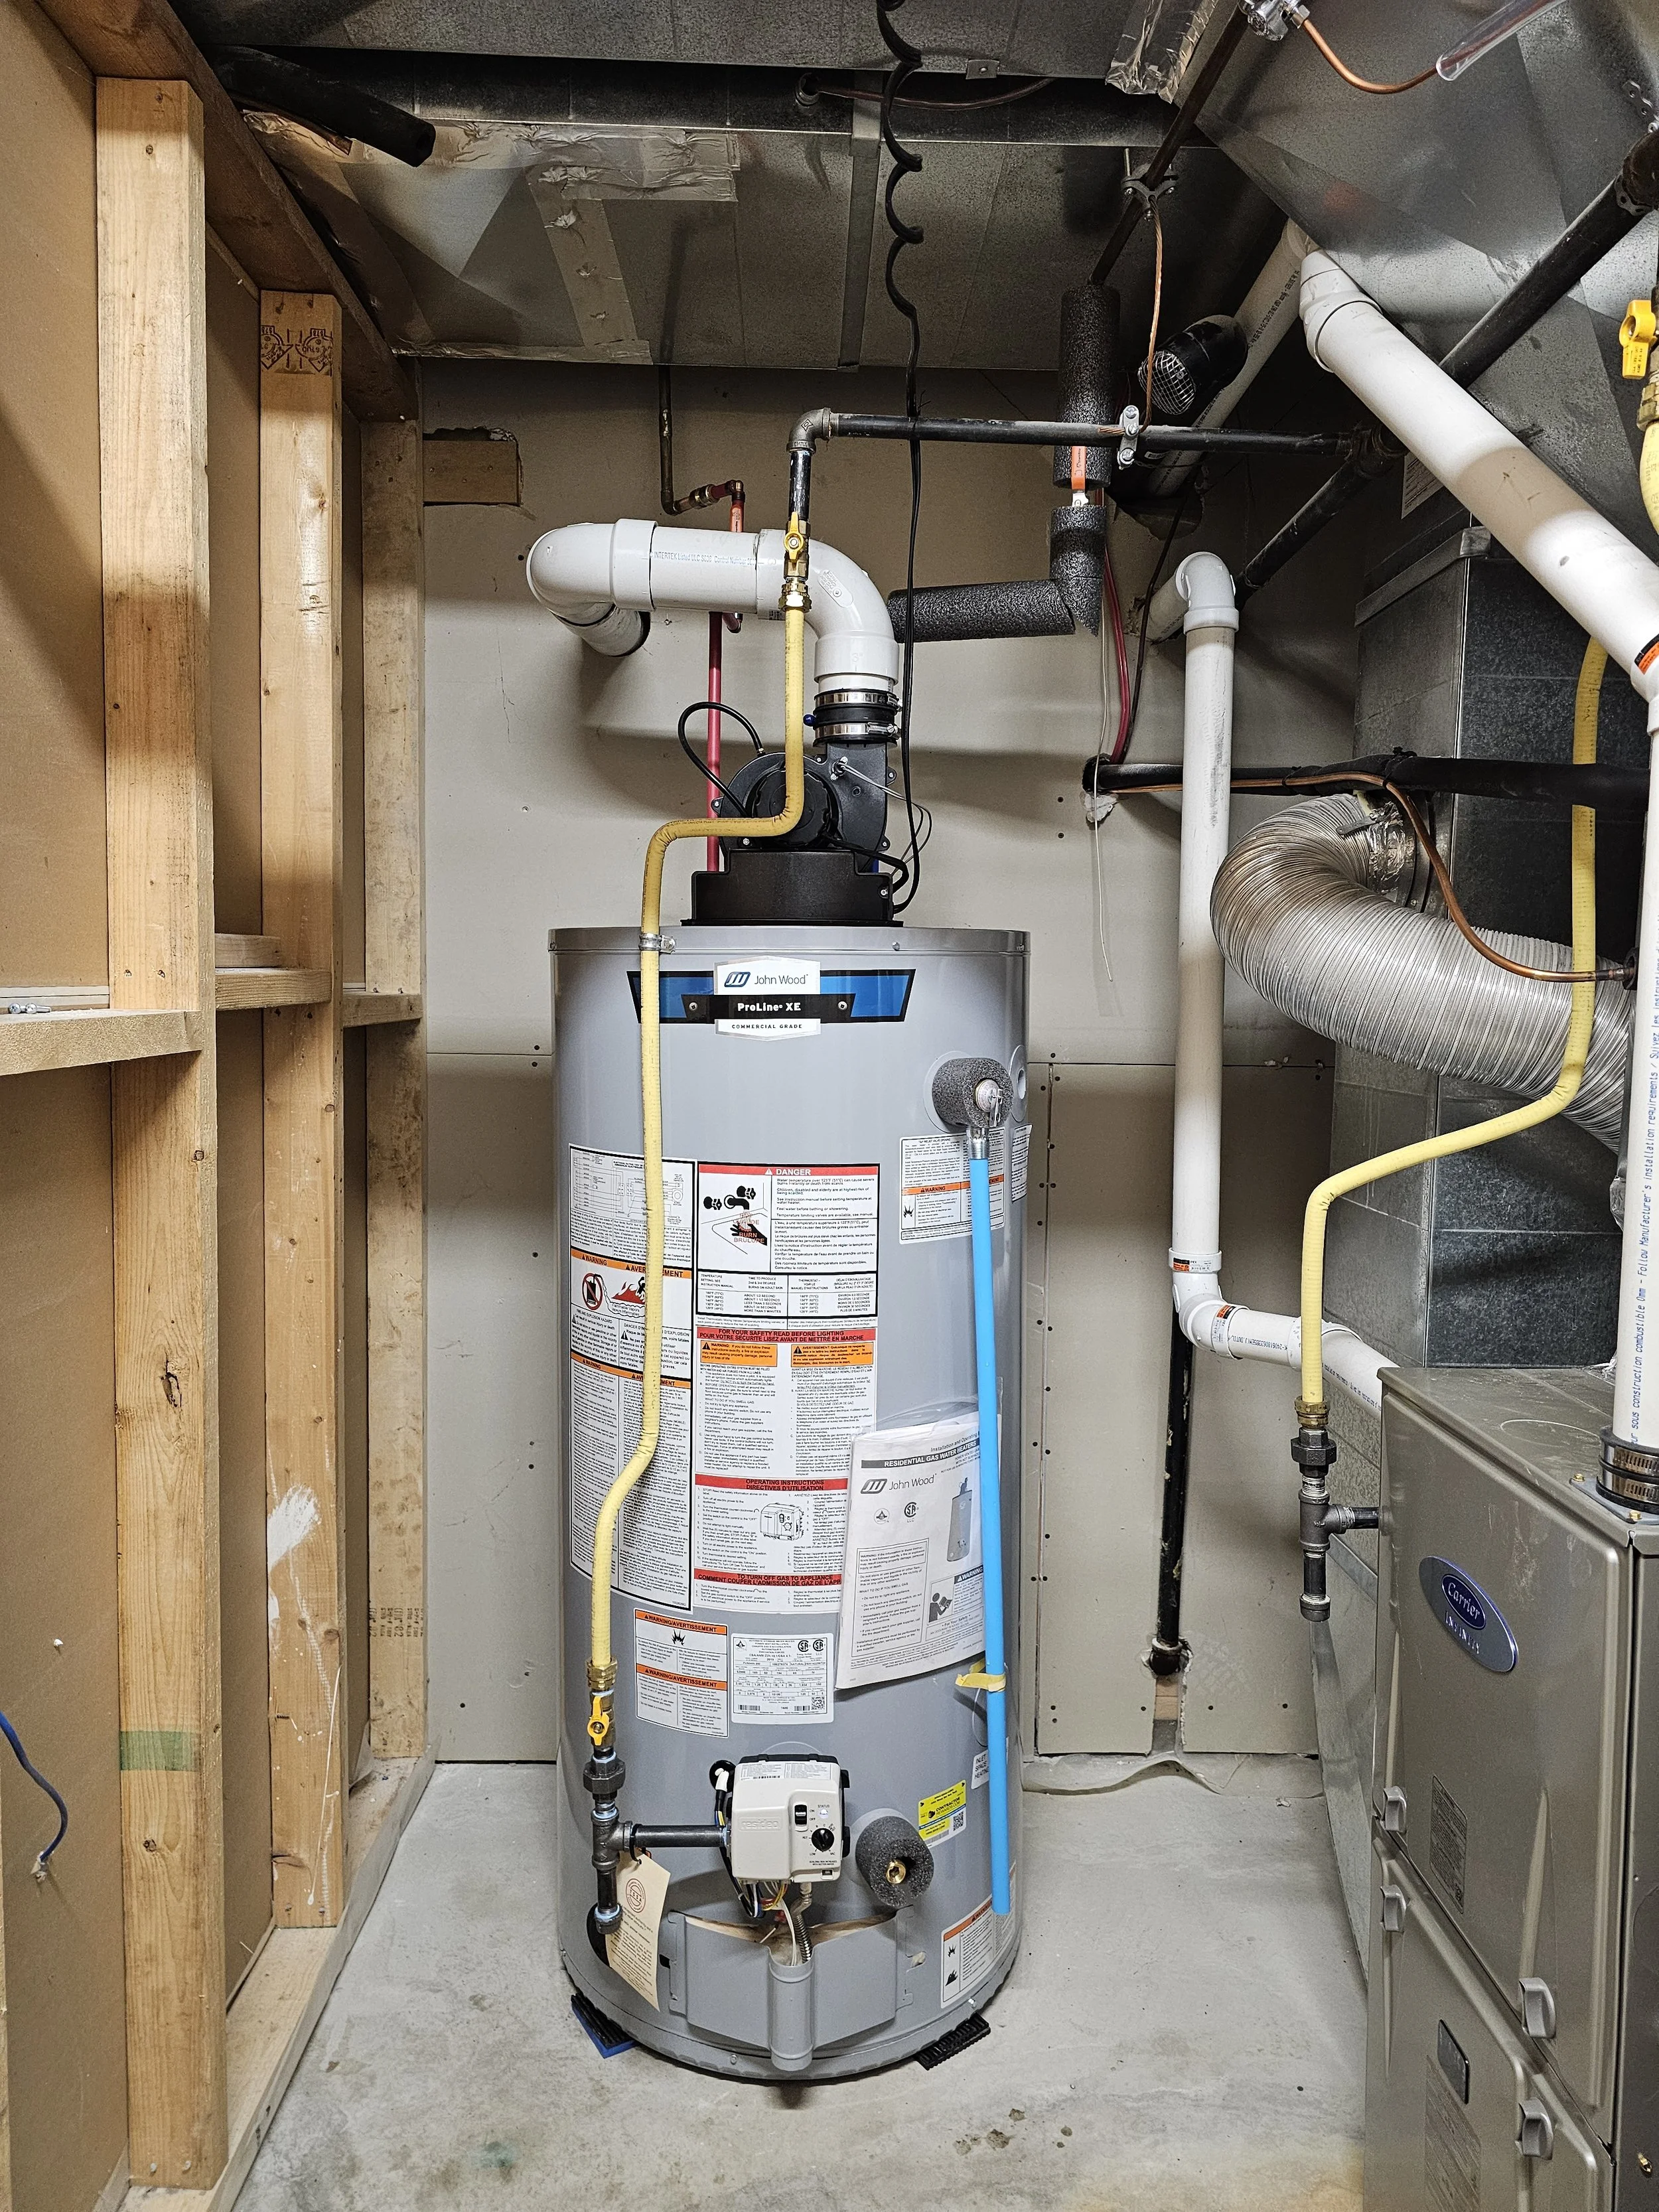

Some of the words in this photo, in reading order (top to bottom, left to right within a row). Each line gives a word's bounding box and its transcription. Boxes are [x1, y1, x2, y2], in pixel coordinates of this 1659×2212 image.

[654, 552, 677, 560] INTERTEK
[755, 976, 776, 985] John
[779, 976, 806, 985] Wood
[1648, 1072, 1658, 1125] requirements
[1643, 1129, 1655, 1180] installation
[1639, 1185, 1652, 1246] Manufacturer's
[585, 1256, 607, 1266] WARNING
[1638, 1250, 1648, 1276] Follow
[1634, 1305, 1645, 1353] combustible
[1632, 1357, 1642, 1408] construction
[930, 1442, 954, 1451] Installation
[962, 1434, 977, 1443] Operating
[884, 1456, 925, 1467] RESIDENTIAL
[940, 1449, 957, 1459] WATER
[957, 1441, 977, 1453] HEATERS
[889, 1481, 909, 1491] John
[912, 1475, 934, 1487] Wood
[962, 1568, 983, 1581] WARNING
[1448, 1582, 1480, 1621] Carrier
[648, 1616, 717, 1632] WARNING/AVERTISSEMENT
[1445, 1611, 1480, 1654] INFINITY
[649, 1669, 717, 1687] WARNING/AVERTISSEMENT
[936, 1797, 960, 1812] CONTRACTOR
[741, 1819, 778, 1828] resideo
